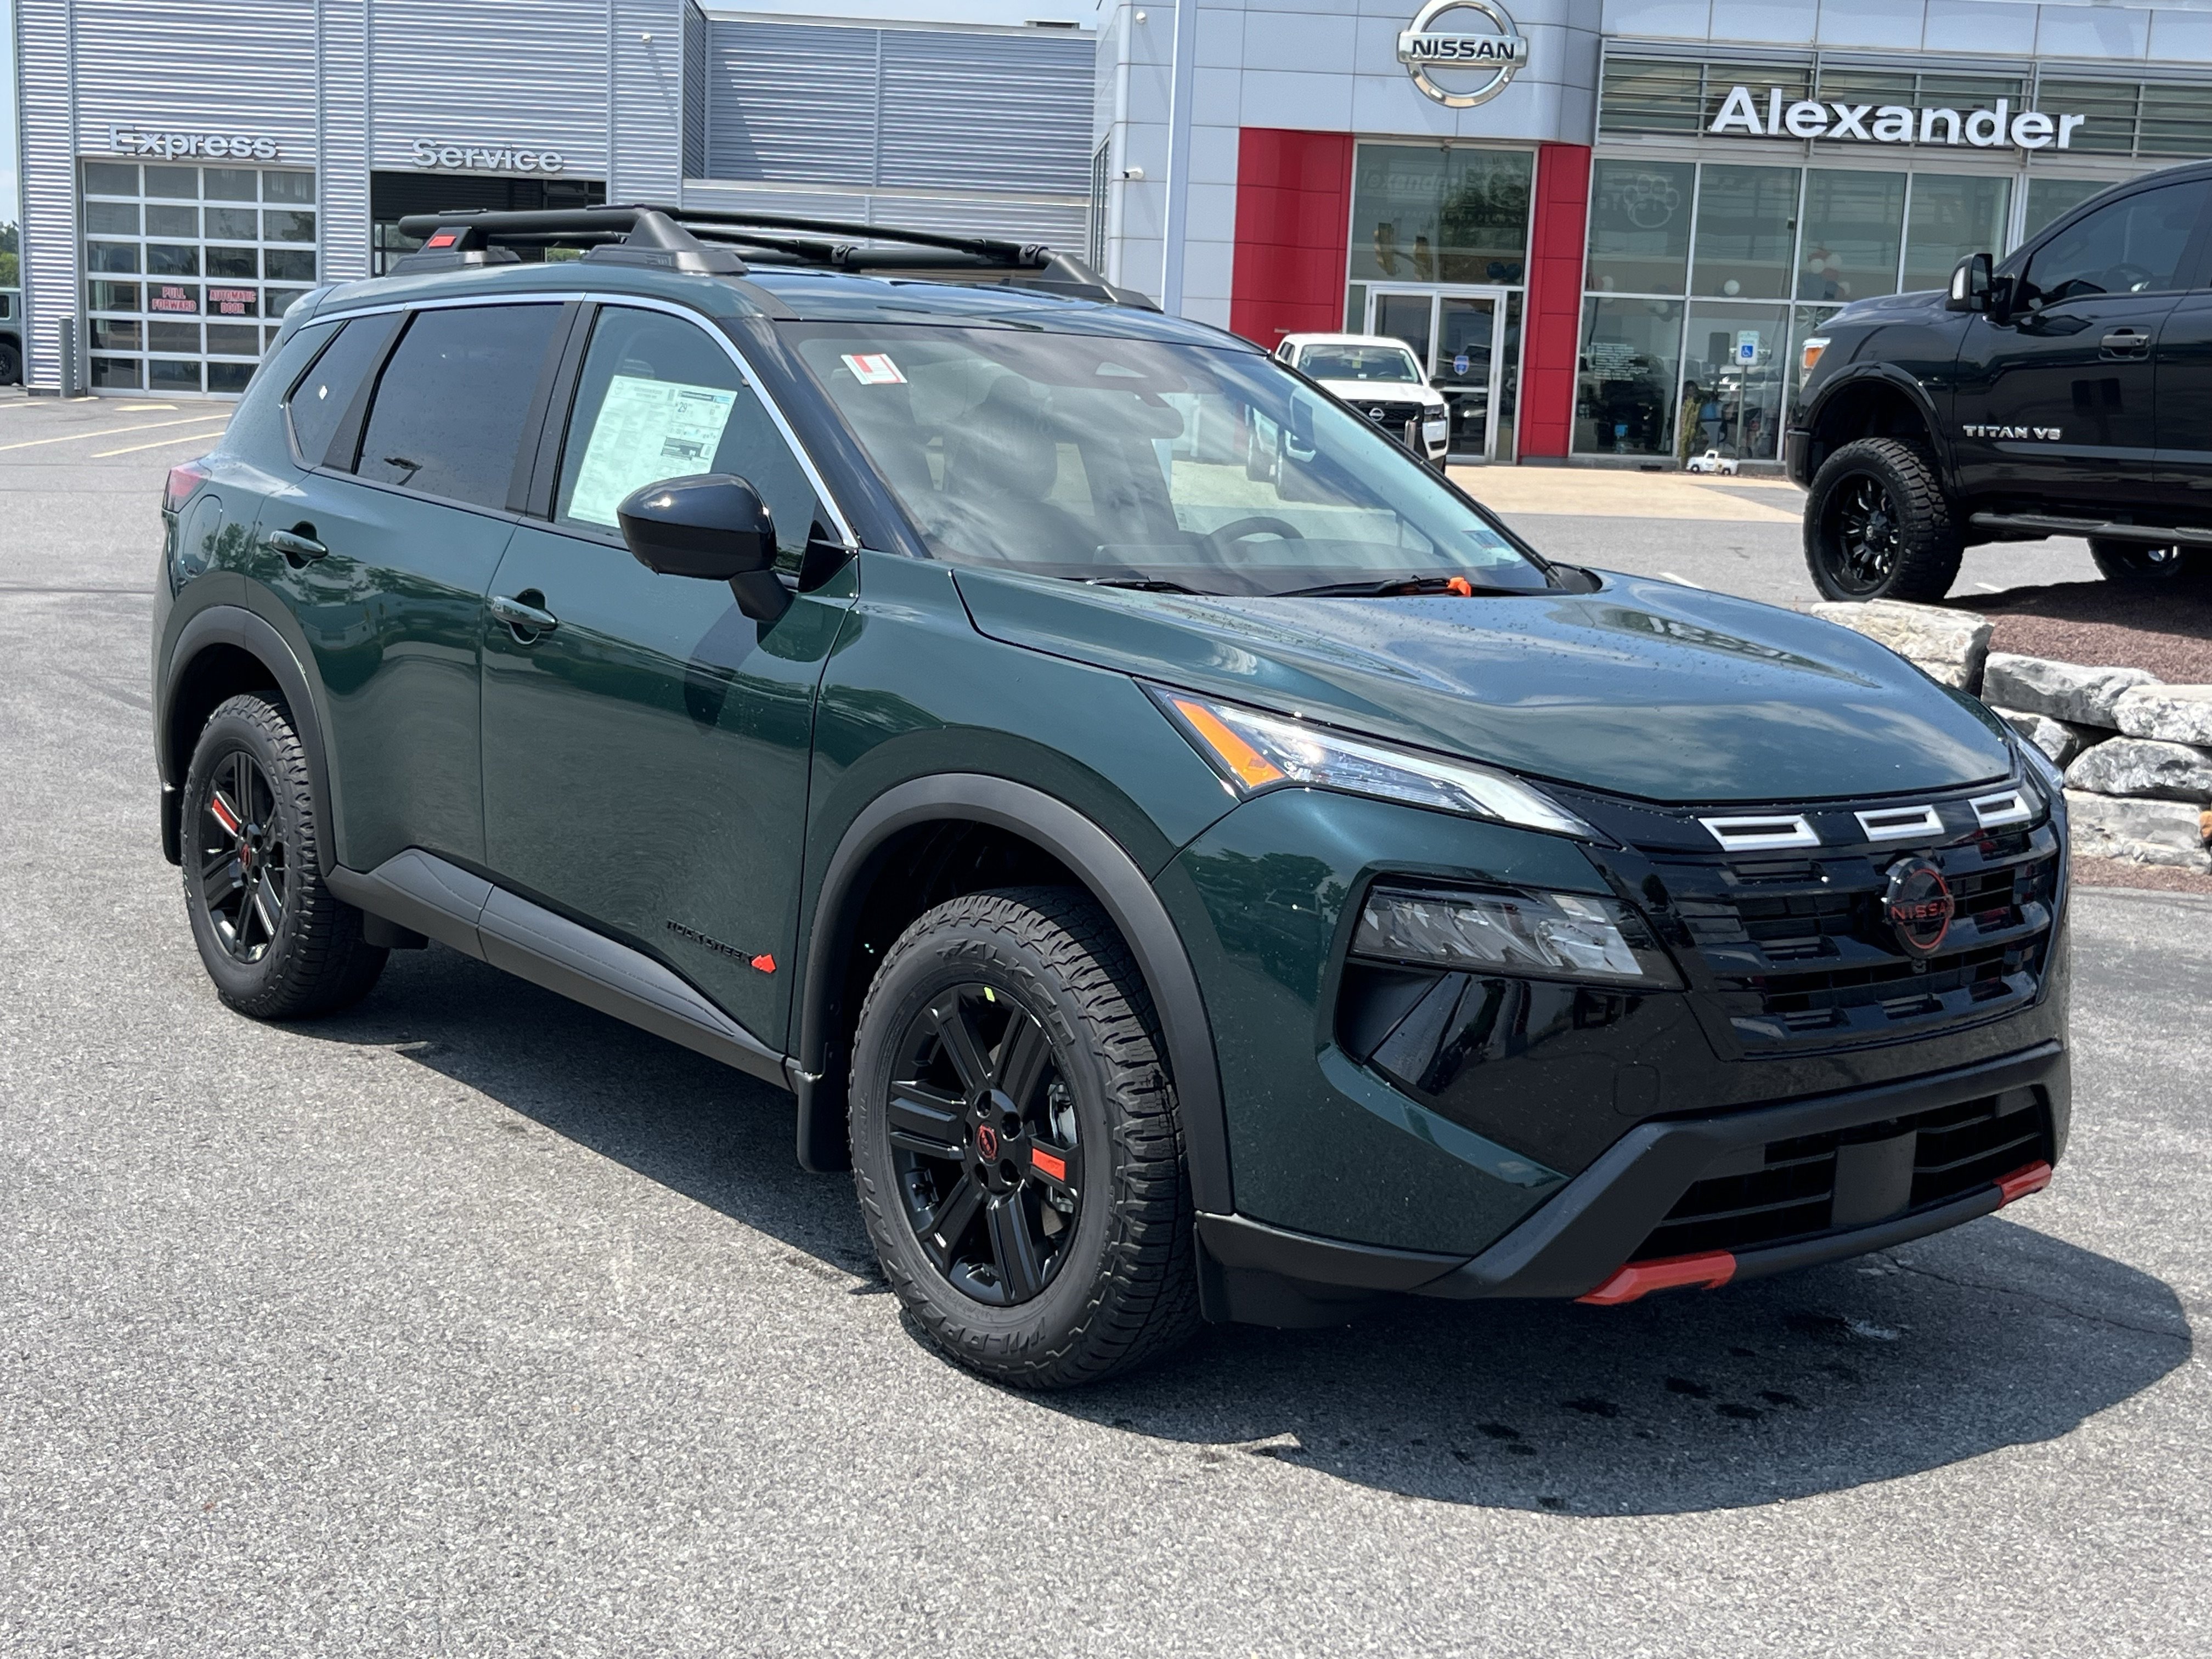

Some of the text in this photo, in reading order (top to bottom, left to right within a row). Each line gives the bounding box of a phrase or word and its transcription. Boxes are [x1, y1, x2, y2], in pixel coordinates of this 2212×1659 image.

[1412, 39, 1515, 60] NISSAN
[1708, 86, 2085, 149] Alexander
[110, 124, 276, 160] Express
[413, 139, 563, 172] Service
[162, 286, 186, 299] PULL
[209, 290, 256, 302] AUTOMATIC
[152, 298, 196, 312] FORWARD
[221, 302, 245, 314] DOOR
[1962, 425, 2061, 440] TITAN V8
[1891, 902, 1945, 919] NISSA
